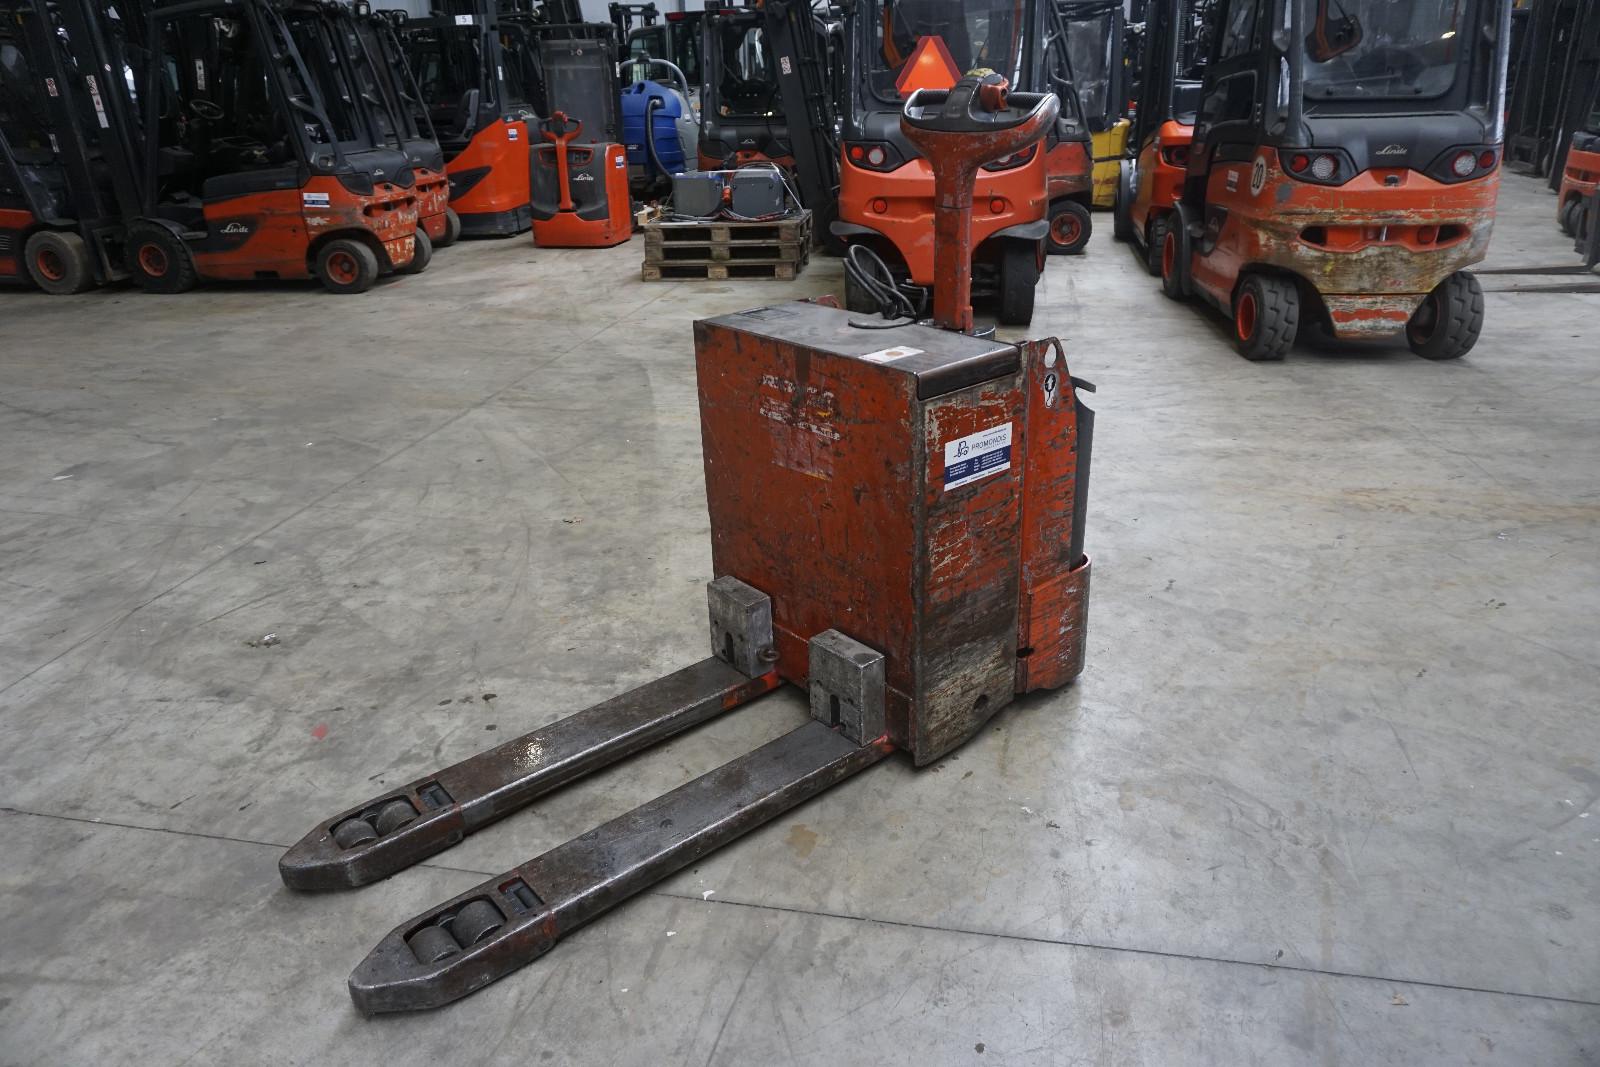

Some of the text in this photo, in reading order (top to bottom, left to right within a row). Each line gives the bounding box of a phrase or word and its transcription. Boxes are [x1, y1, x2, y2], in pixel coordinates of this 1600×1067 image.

[1376, 144, 1408, 155] Linde
[1252, 163, 1264, 189] 20
[220, 223, 249, 233] Linde
[971, 433, 1007, 449] PROMONDIS
